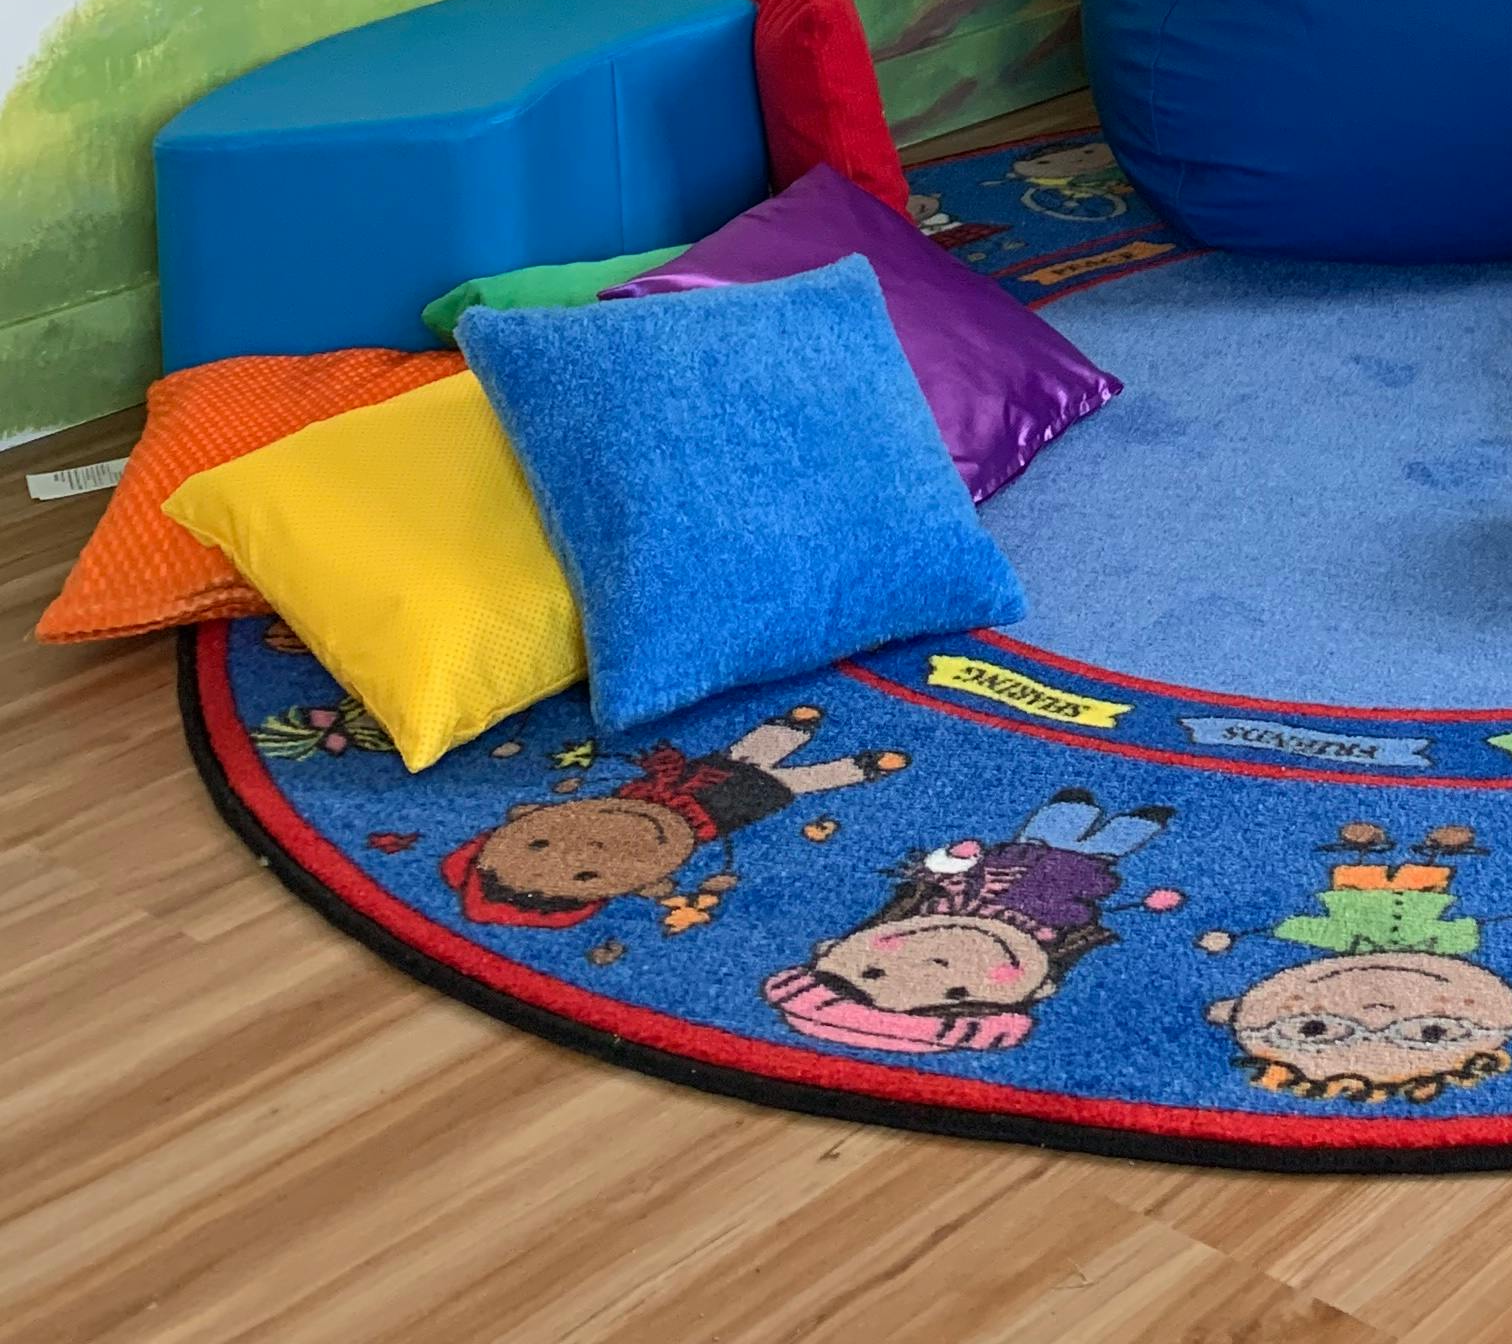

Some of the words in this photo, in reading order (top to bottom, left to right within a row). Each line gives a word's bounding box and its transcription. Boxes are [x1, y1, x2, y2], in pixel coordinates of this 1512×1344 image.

[1051, 251, 1134, 275] PEACE
[952, 665, 1092, 718] SHARING
[1220, 724, 1378, 759] FRIENDS
